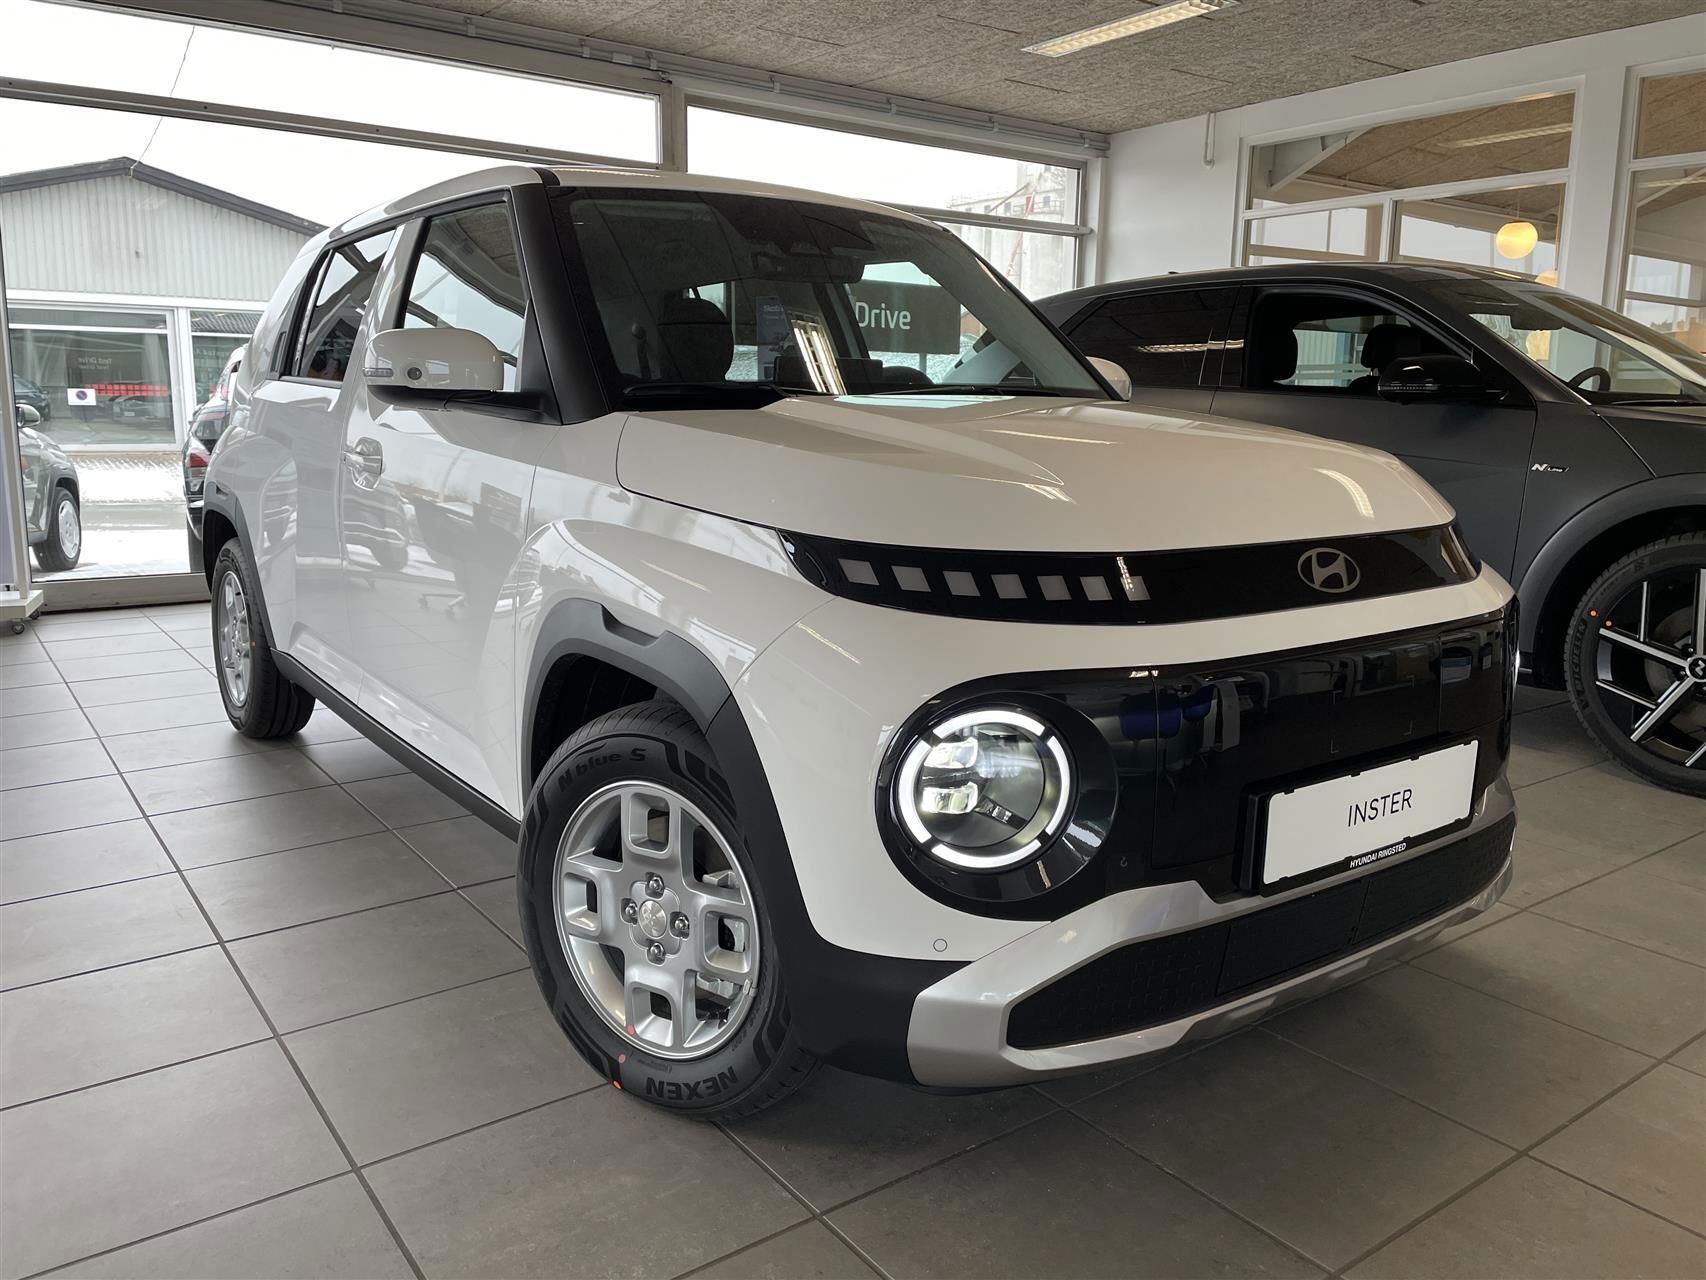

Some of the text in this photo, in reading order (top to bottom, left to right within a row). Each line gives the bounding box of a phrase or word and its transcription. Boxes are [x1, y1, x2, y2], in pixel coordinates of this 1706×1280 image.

[856, 302, 911, 330] Drive
[1531, 463, 1548, 472] N
[1572, 622, 1586, 692] MICHELIN
[558, 748, 647, 792] N blue S
[1347, 788, 1413, 827] INSTER
[1349, 842, 1407, 869] HYUNDAI RINGSTED
[646, 1065, 738, 1100] NEXEN
